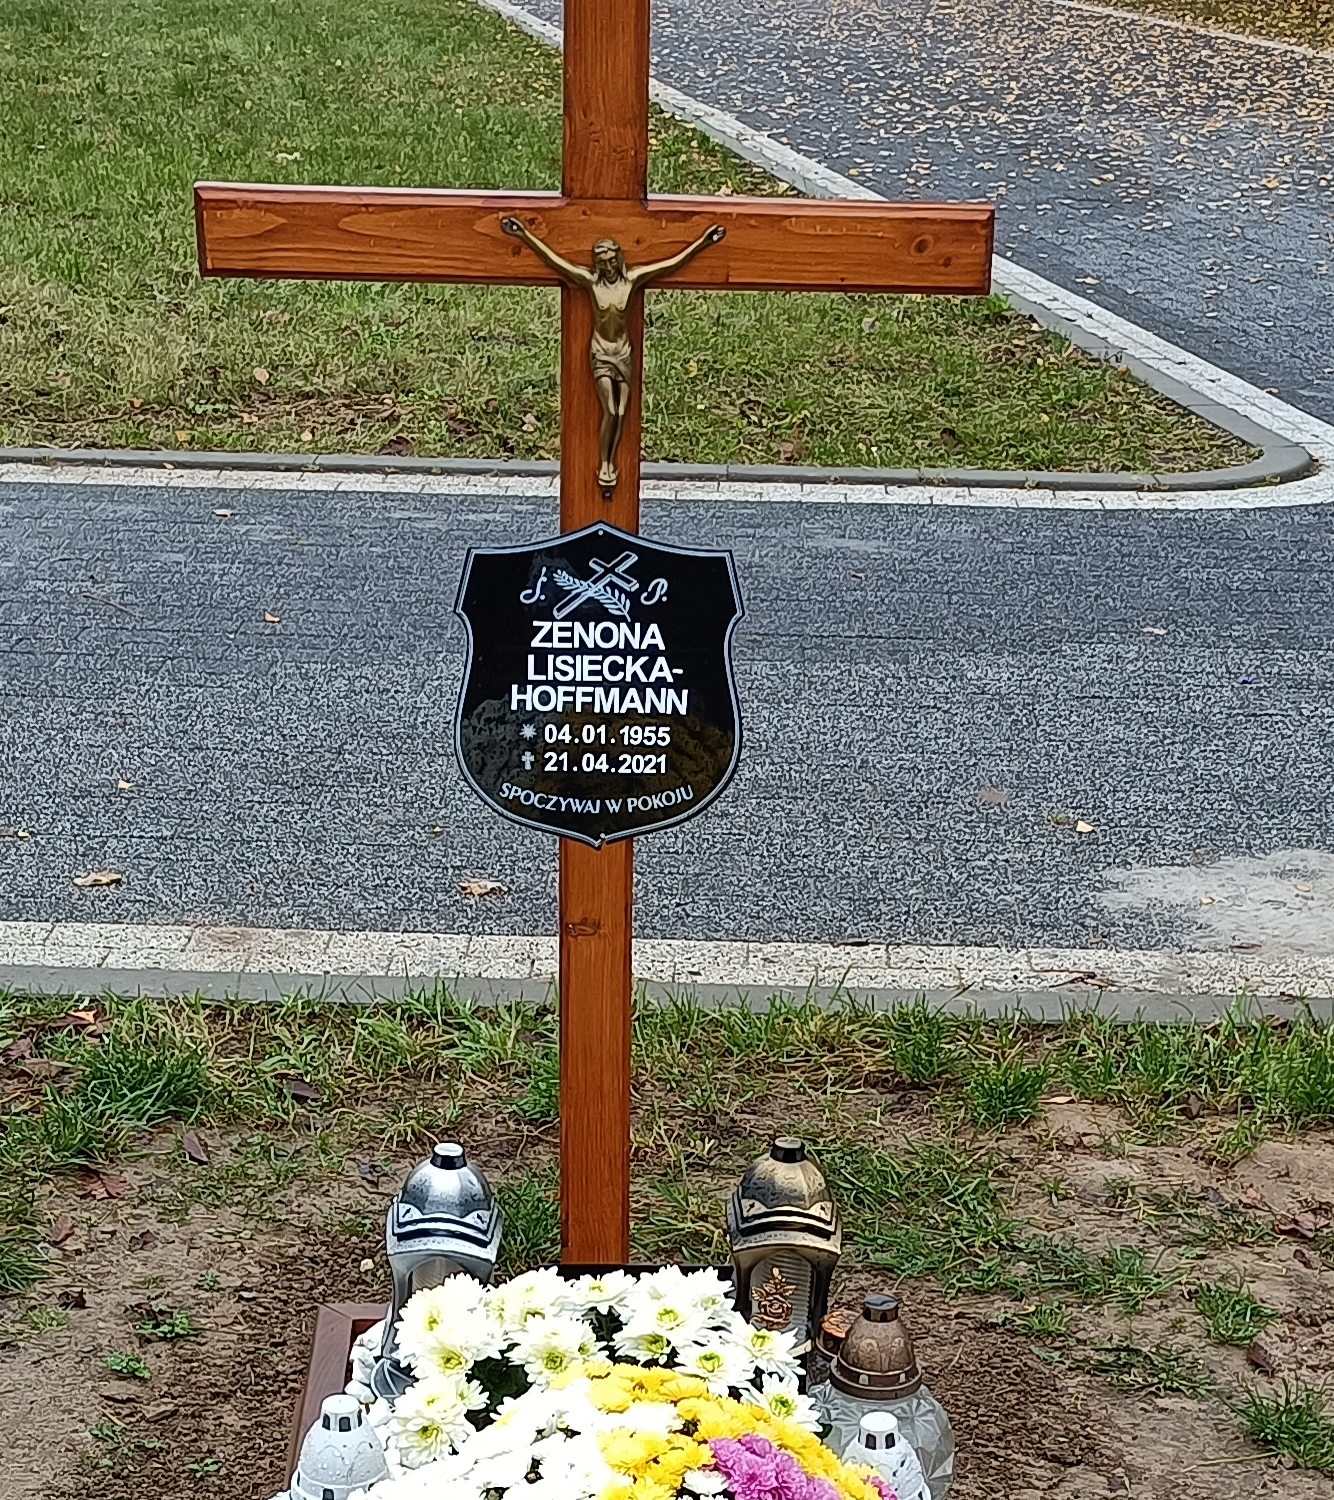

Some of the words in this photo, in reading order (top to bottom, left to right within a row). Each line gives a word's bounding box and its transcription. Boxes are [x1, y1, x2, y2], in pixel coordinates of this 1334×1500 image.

[640, 578, 668, 605] P.
[531, 620, 666, 650] ZENONA
[527, 654, 684, 683] LISIECKA-
[510, 684, 688, 715] HOFFMANN
[544, 724, 671, 746] 04.01.1955
[543, 752, 666, 774] 21.04.2021
[499, 782, 601, 814] SPOCZYWAJ
[605, 799, 623, 813] W
[627, 785, 694, 814] POKOJU
